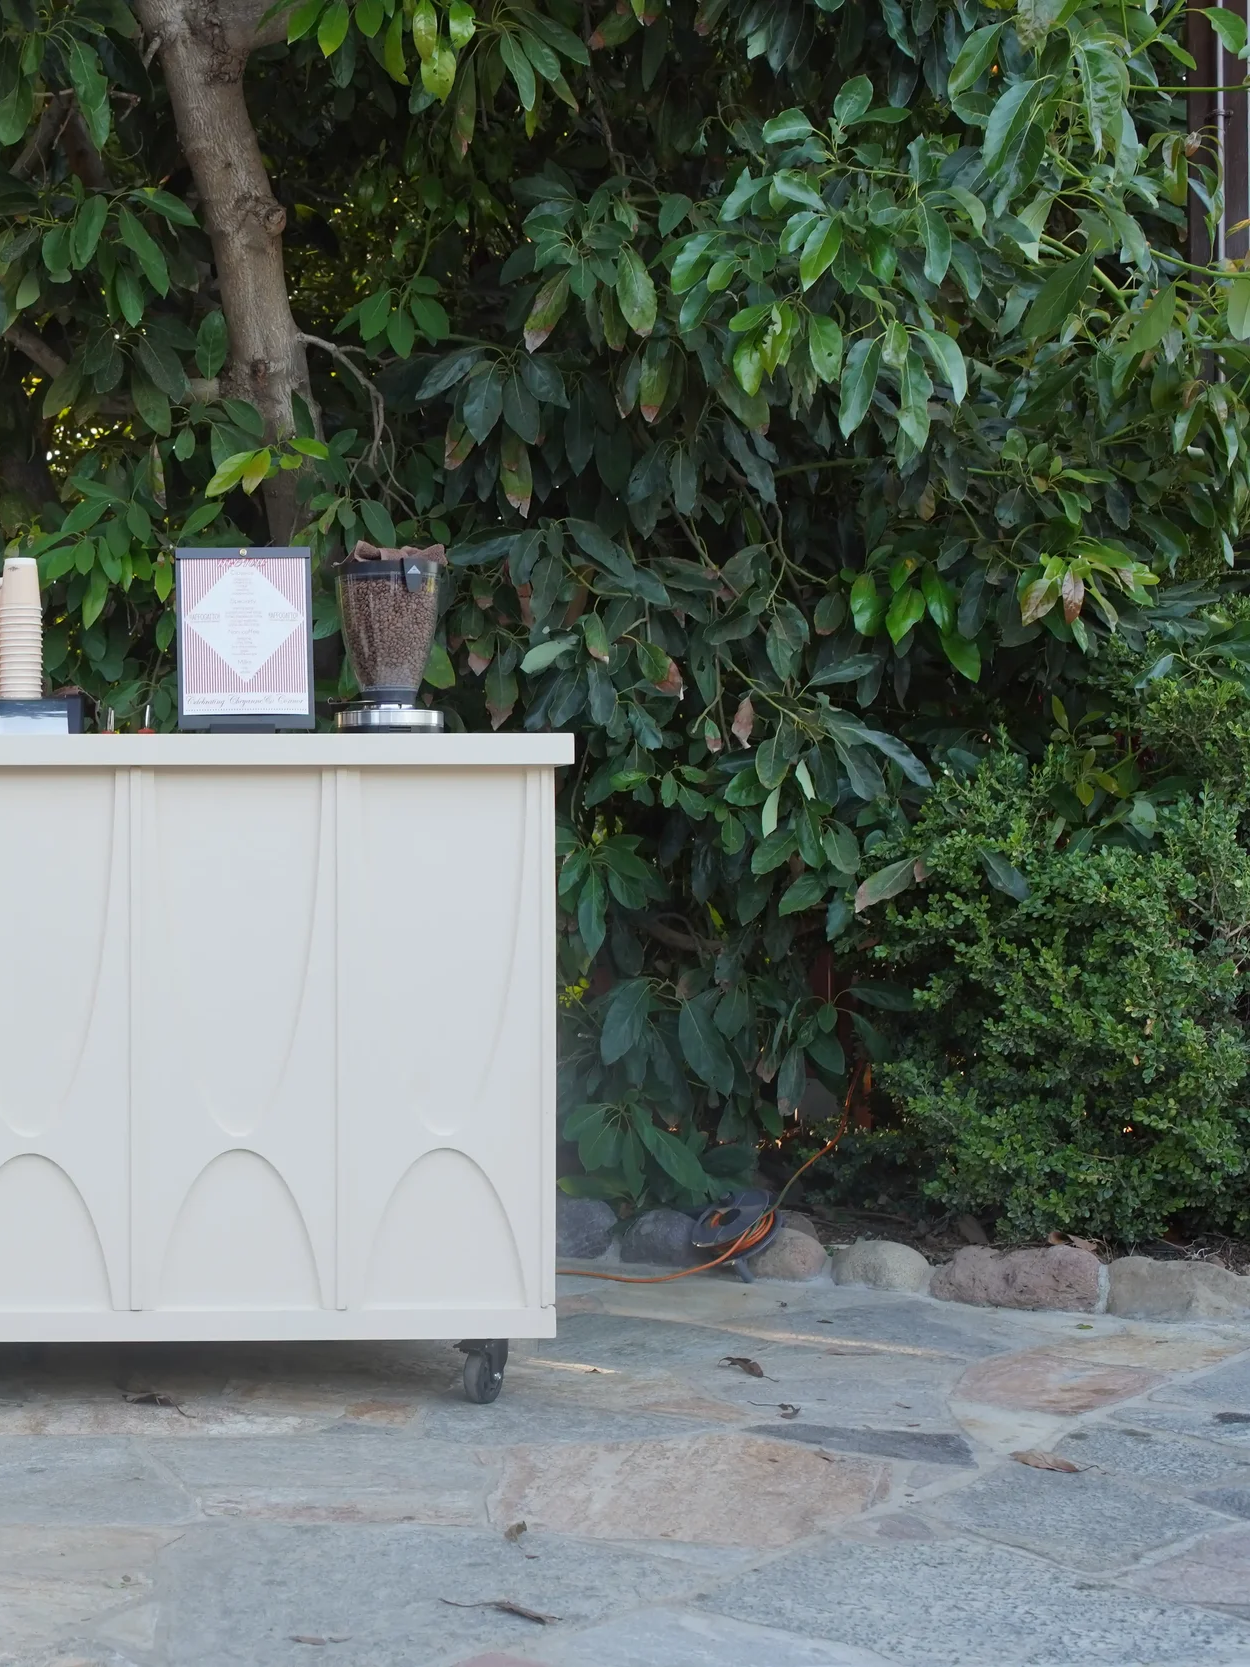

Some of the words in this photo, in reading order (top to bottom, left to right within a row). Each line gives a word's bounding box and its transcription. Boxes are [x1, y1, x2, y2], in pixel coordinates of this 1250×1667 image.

[186, 696, 225, 708] Celebrating
[228, 694, 263, 707] Cheyanne
[276, 694, 304, 704] Connor
